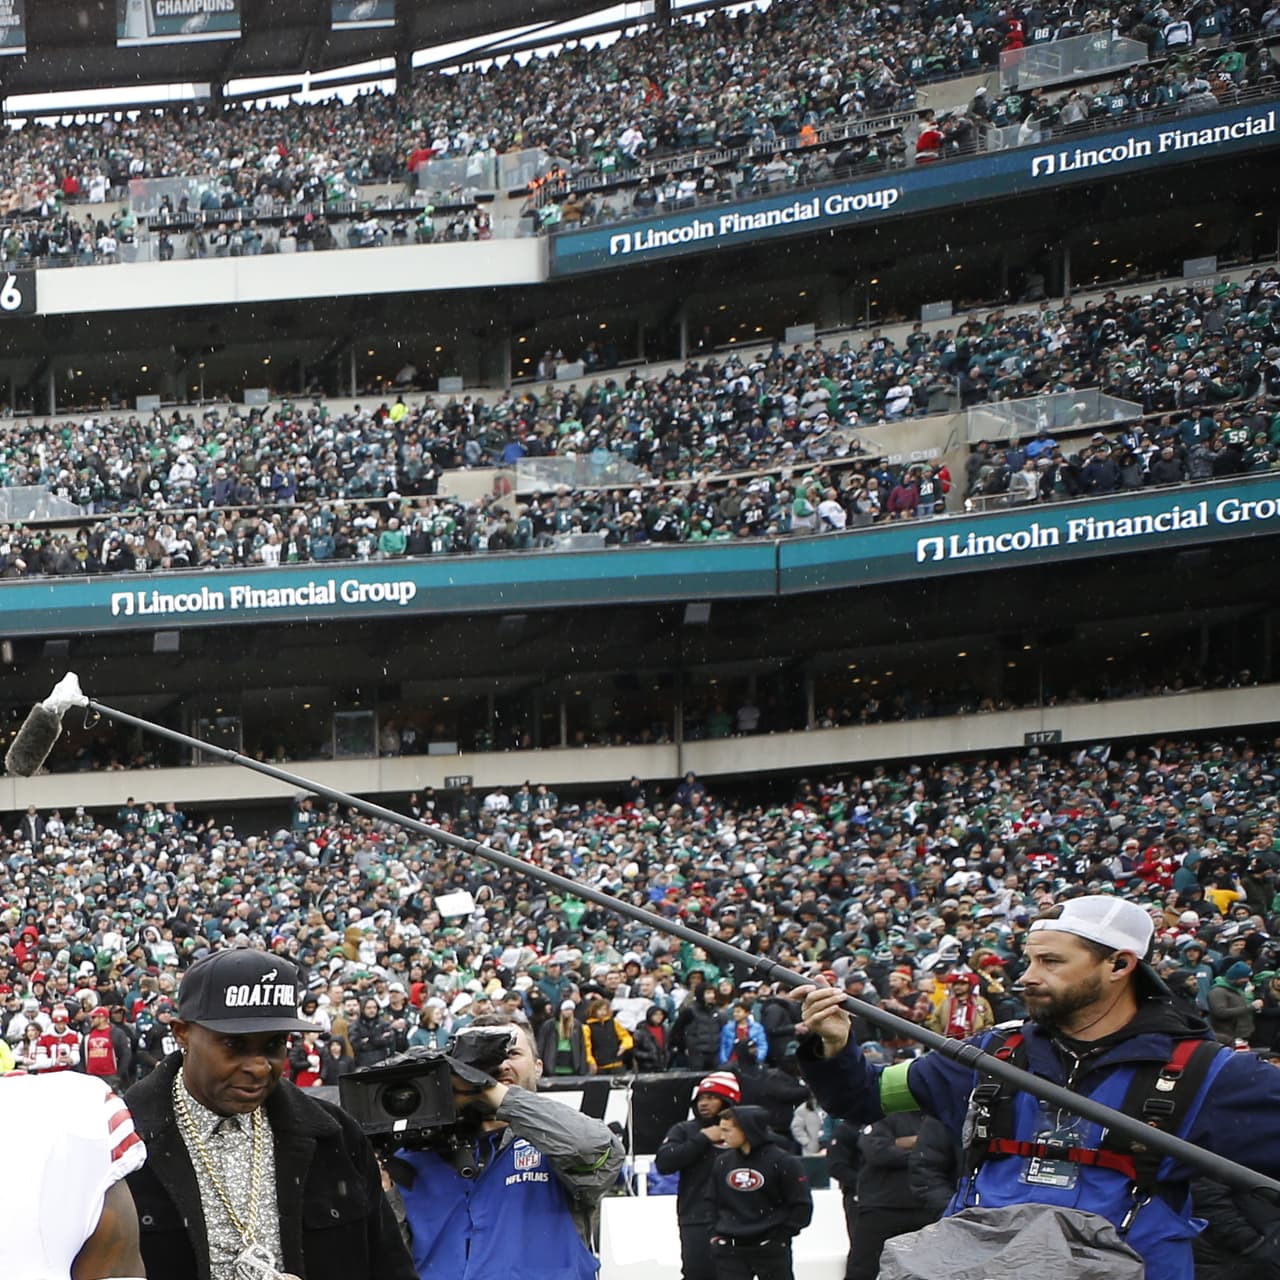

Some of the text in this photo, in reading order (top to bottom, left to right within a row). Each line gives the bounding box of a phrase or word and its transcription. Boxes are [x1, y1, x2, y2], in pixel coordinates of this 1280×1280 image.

[156, 0, 234, 17] CHAMPIONS
[1059, 111, 1275, 172] Lincoln Financial
[633, 188, 898, 251] Lincoln Financial Group
[949, 498, 1280, 558] Lincoln Financial Gro
[138, 580, 417, 615] Lincoln Financial Group
[1031, 732, 1055, 741] 117
[505, 1172, 549, 1185] NFL FILMS
